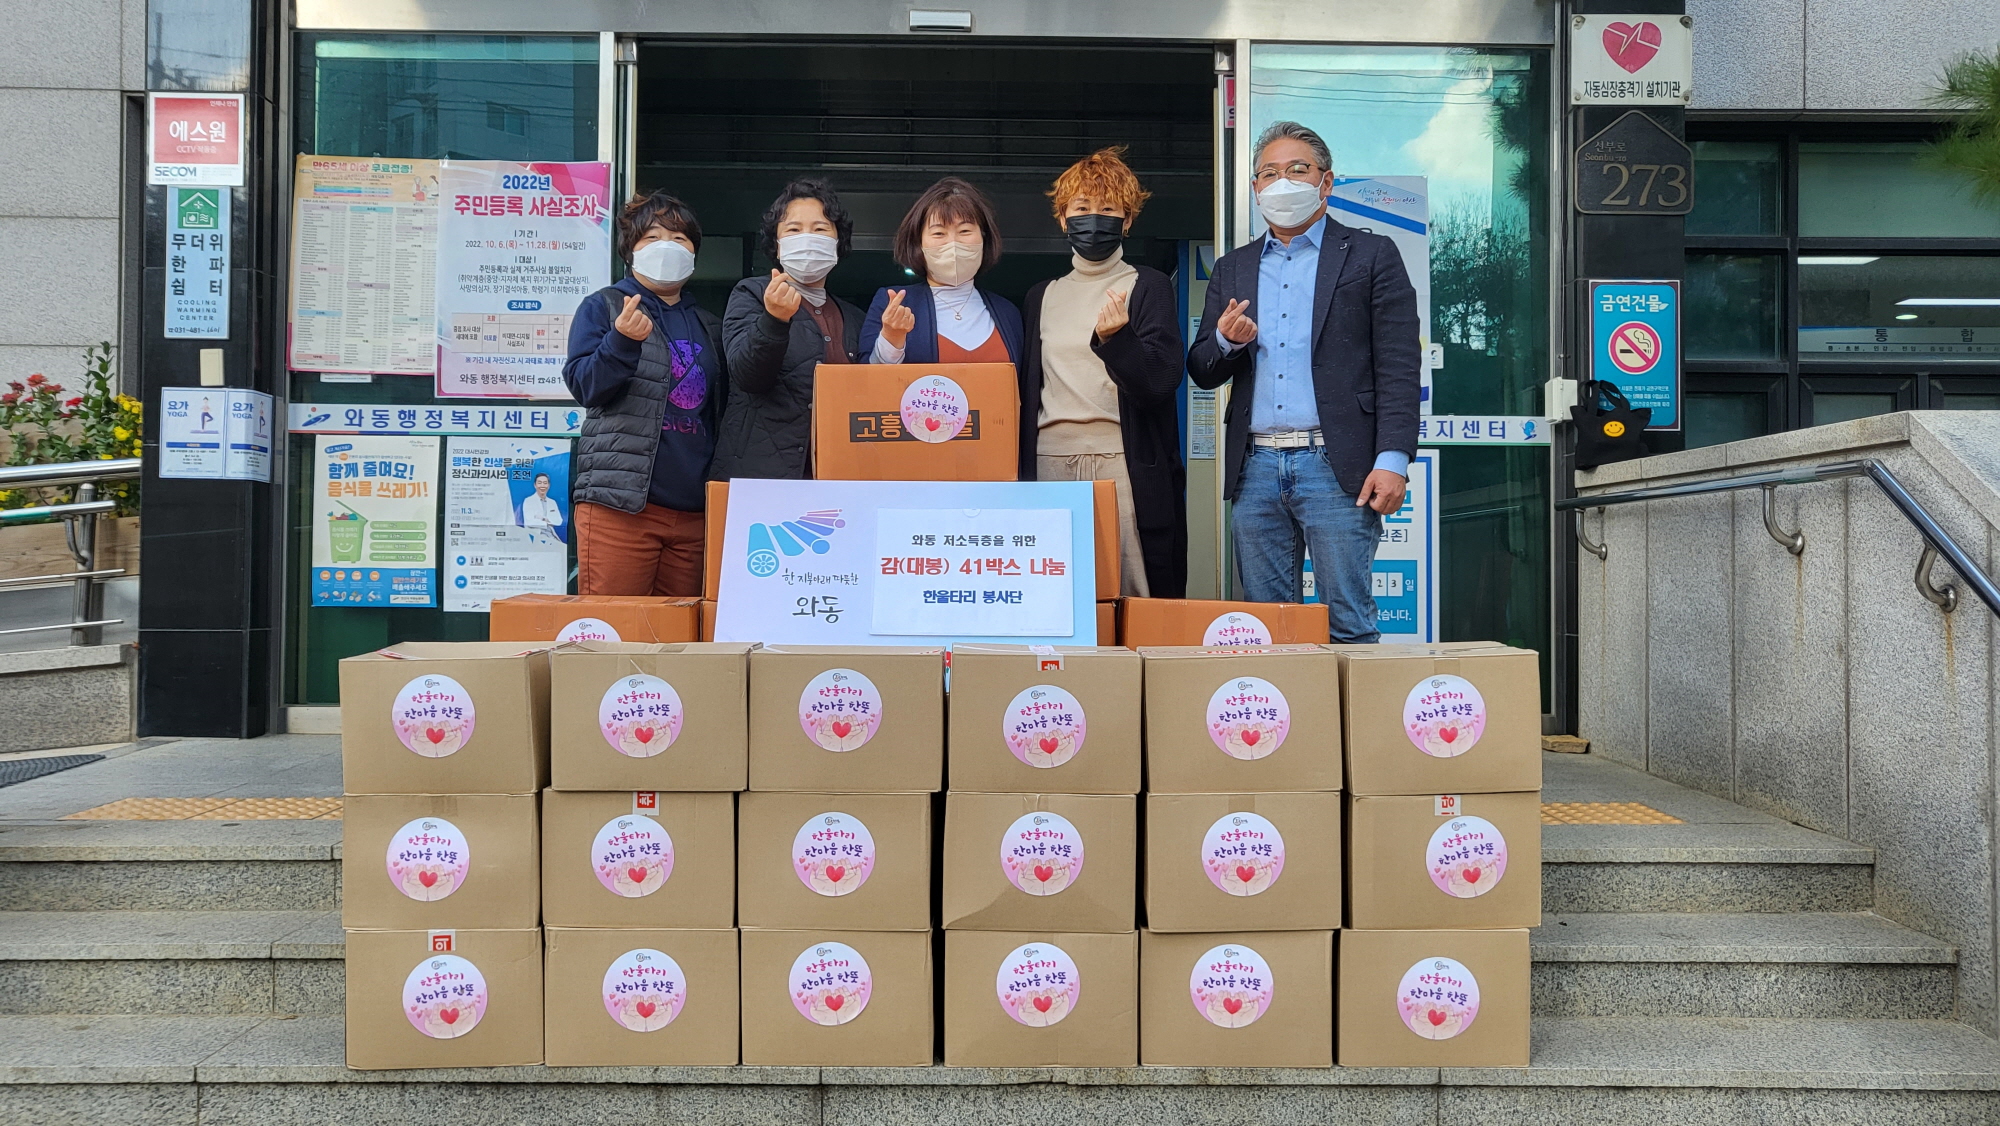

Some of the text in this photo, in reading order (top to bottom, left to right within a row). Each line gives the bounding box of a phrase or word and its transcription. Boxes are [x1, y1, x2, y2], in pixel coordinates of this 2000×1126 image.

[1583, 80, 1681, 98] 자동심장충격기 설치기관
[169, 120, 226, 143] 에스원
[1594, 140, 1626, 152] 선부로
[154, 166, 197, 177] SECOM
[312, 161, 348, 172] 만65세
[502, 174, 550, 190] 2022년
[1601, 163, 1687, 207] 273
[454, 195, 597, 217] 주민등록 사실조사
[518, 230, 534, 238] 기간
[171, 233, 223, 252] 무더위
[562, 242, 586, 250] (54일간)
[518, 256, 532, 264] 대상
[1600, 294, 1662, 312] 금연건물
[460, 374, 535, 384] 와동 행정복지센터
[167, 400, 189, 410] 요가
[232, 402, 254, 412] 요가
[232, 412, 253, 420] YOGA
[344, 408, 550, 430] 와동행정복지센터
[452, 456, 534, 468] 행복한 인생을 위한
[328, 460, 414, 480] 함께 줄여요!
[452, 468, 532, 480] 정신과의사의 조언
[328, 480, 428, 498] 음식물 쓰레기!
[912, 534, 1036, 546] 와동 저소득층을 위한
[880, 556, 1066, 576] 감(대봉) 41박스 나눔
[782, 568, 859, 586] 한 지붕아래 따뜻한
[923, 590, 1024, 604] 한울타리 봉사단
[792, 596, 844, 624] 와동
[411, 690, 455, 703] 한울타리
[617, 690, 661, 704] 한울타리
[818, 685, 863, 697] 한울타리
[1420, 691, 1463, 705] 한울타리
[811, 697, 845, 713] 한마음
[1225, 693, 1269, 706] 한울타리
[404, 704, 438, 719] 한마음
[611, 704, 645, 721] 한마음
[1020, 701, 1063, 716] 한울타리
[1218, 706, 1252, 722] 한마음
[1415, 703, 1448, 721] 한마음
[1015, 714, 1049, 733] 한마음
[408, 833, 451, 846] 한울타리
[607, 831, 651, 846] 한울타리
[811, 828, 855, 841] 한울타리
[1020, 827, 1064, 840] 한울타리
[1221, 829, 1264, 841] 한울타리
[1442, 832, 1484, 848] 한울타리
[399, 846, 433, 861] 한마음
[603, 844, 636, 864] 한마음
[804, 841, 838, 857] 한마음
[1012, 842, 1047, 858] 한마음
[1213, 842, 1247, 858] 한마음
[1438, 845, 1470, 865] 한마음
[623, 964, 667, 977] 한울타리
[805, 959, 849, 973] 한울타리
[1013, 959, 1057, 974] 한울타리
[1210, 960, 1254, 973] 한울타리
[420, 972, 464, 987] 한울타리
[615, 978, 649, 993] 한마음
[801, 971, 833, 990] 한마음
[1009, 973, 1041, 992] 한마음
[1202, 974, 1237, 989] 한마음
[1419, 972, 1462, 987] 한울타리
[415, 985, 449, 1004] 한마음
[1409, 985, 1443, 1000] 한마음
